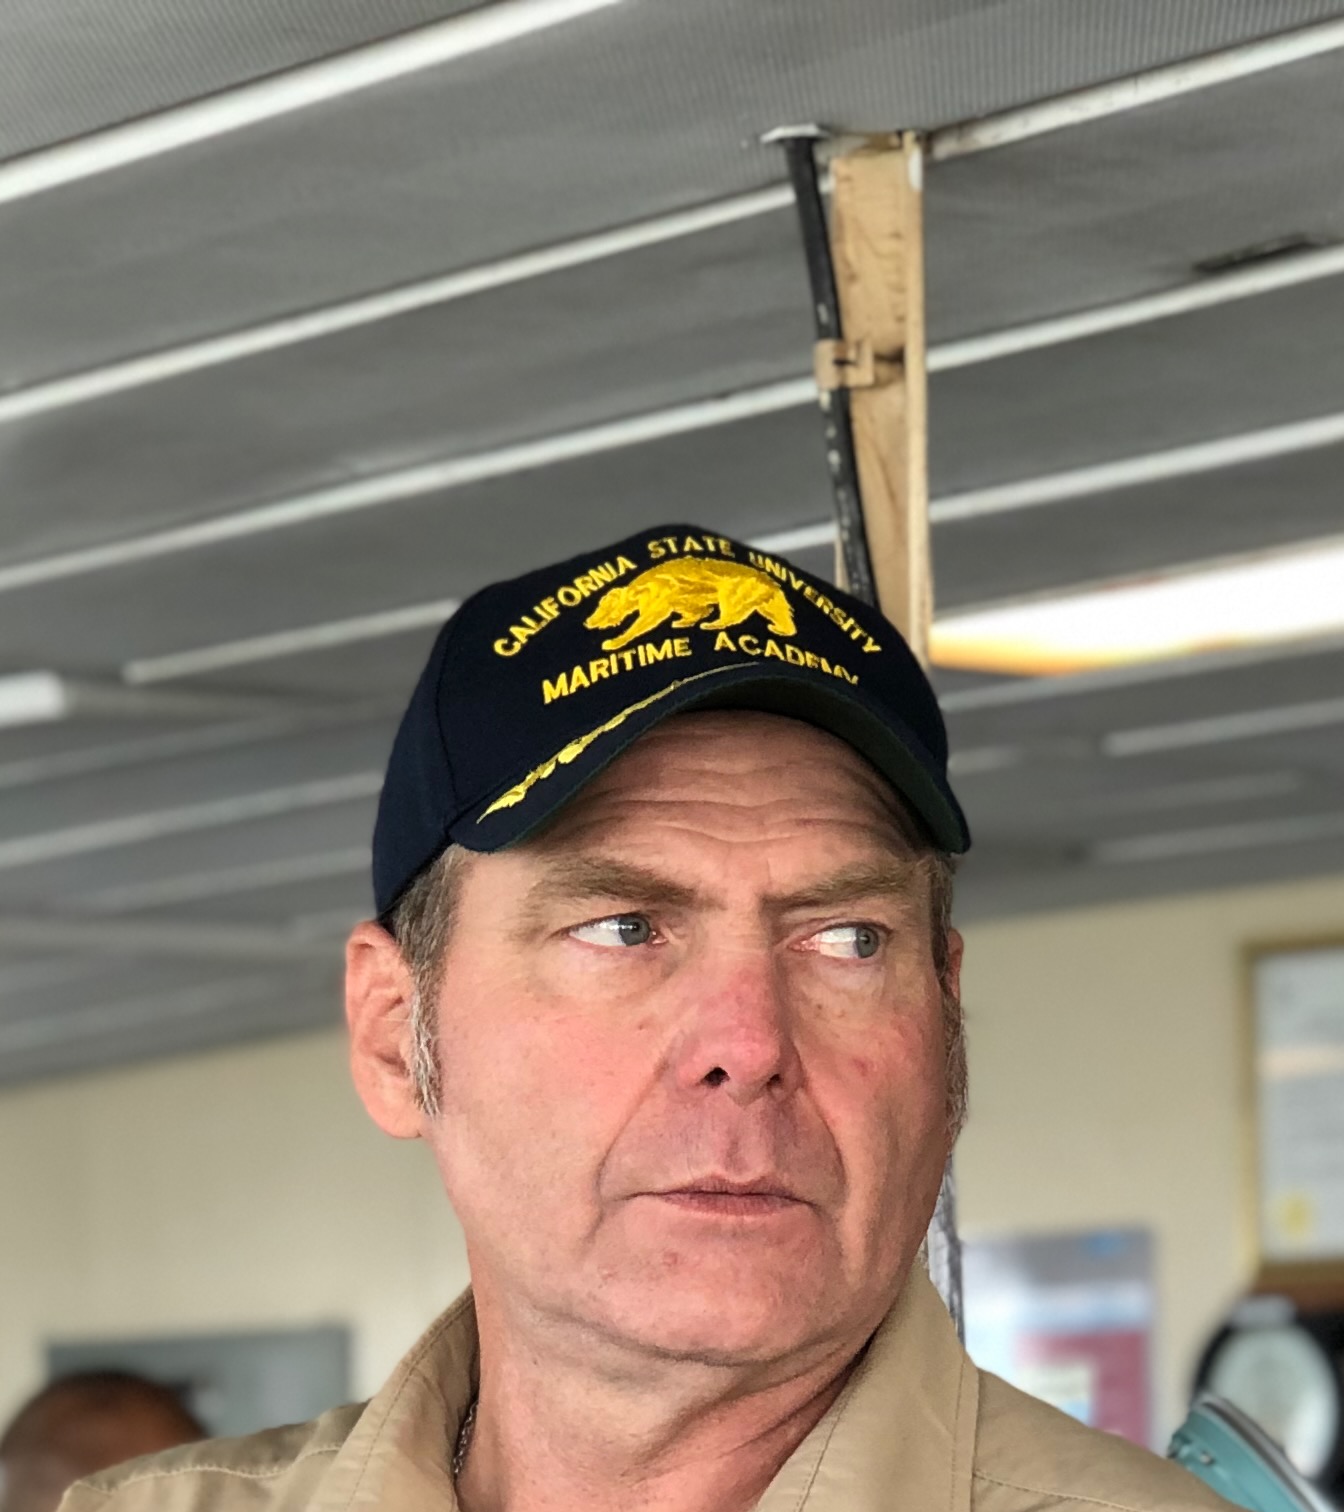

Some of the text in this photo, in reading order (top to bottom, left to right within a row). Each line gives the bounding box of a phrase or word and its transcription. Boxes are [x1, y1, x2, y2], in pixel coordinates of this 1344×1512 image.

[493, 535, 882, 657] CALIFORNIA STATE UNIVERSITY
[542, 637, 693, 705] MARITIME
